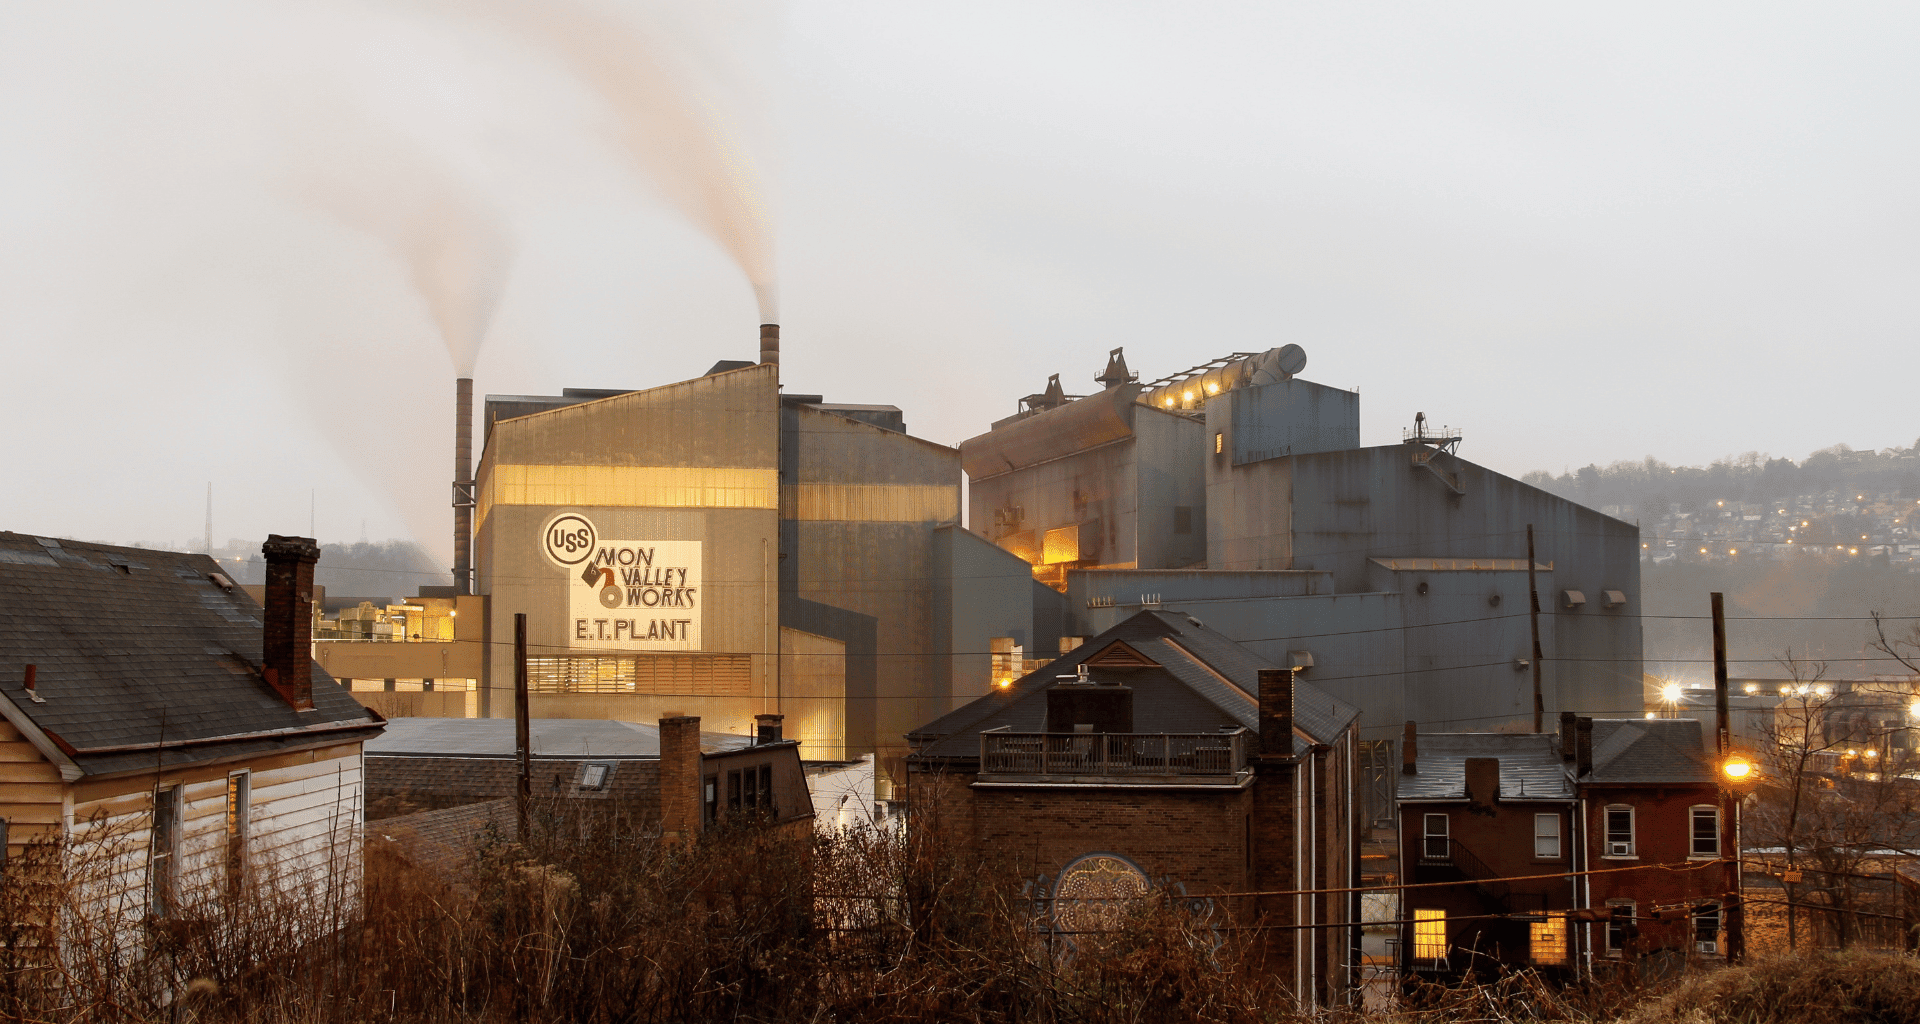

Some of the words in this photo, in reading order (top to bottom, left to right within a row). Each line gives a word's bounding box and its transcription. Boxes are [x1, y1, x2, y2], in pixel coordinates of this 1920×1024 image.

[554, 528, 588, 553] USS
[595, 548, 653, 565] MON
[621, 569, 686, 586] VALLEY
[627, 589, 695, 607] WORKS
